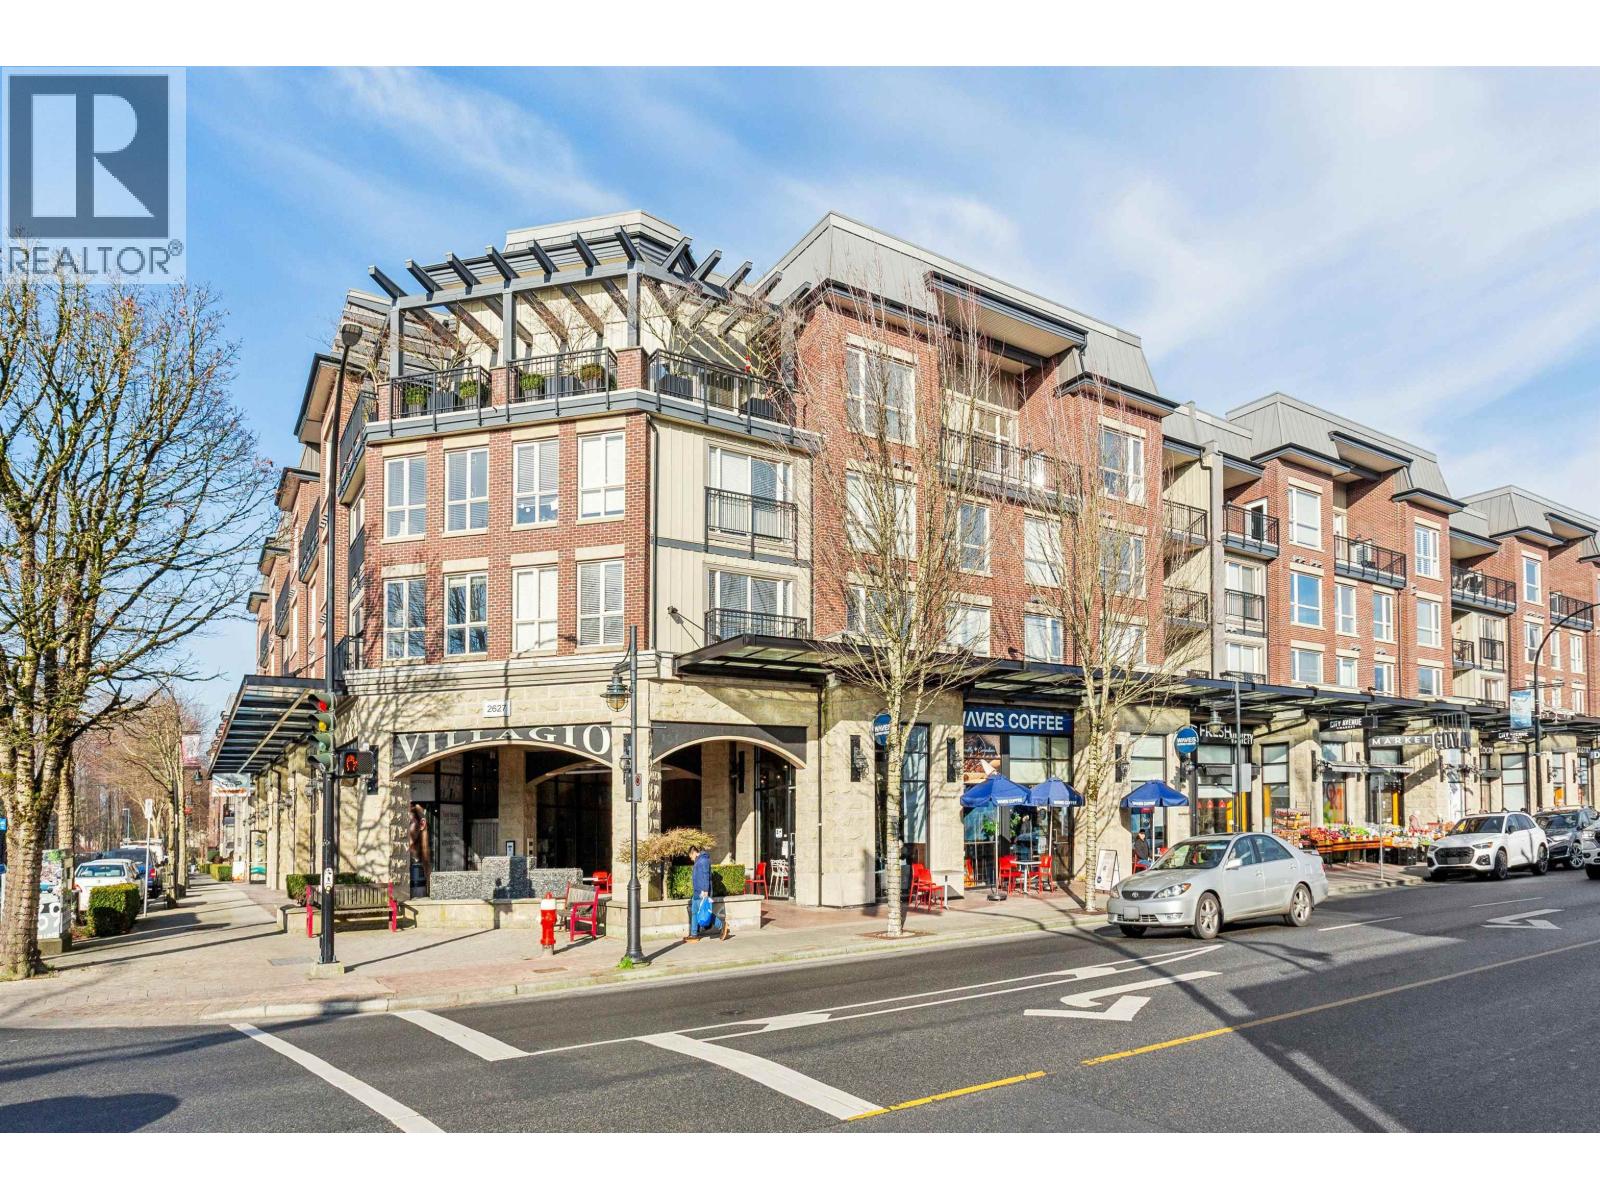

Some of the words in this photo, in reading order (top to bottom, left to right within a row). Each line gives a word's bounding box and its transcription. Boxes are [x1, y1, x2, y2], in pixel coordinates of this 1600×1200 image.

[487, 704, 507, 713] 2627
[1008, 713, 1064, 731] COFFEE
[1342, 718, 1362, 727] AVENUE
[397, 724, 611, 763] VILLAGIO
[1231, 733, 1253, 745] VAIETY
[1372, 736, 1430, 745] MARKET
